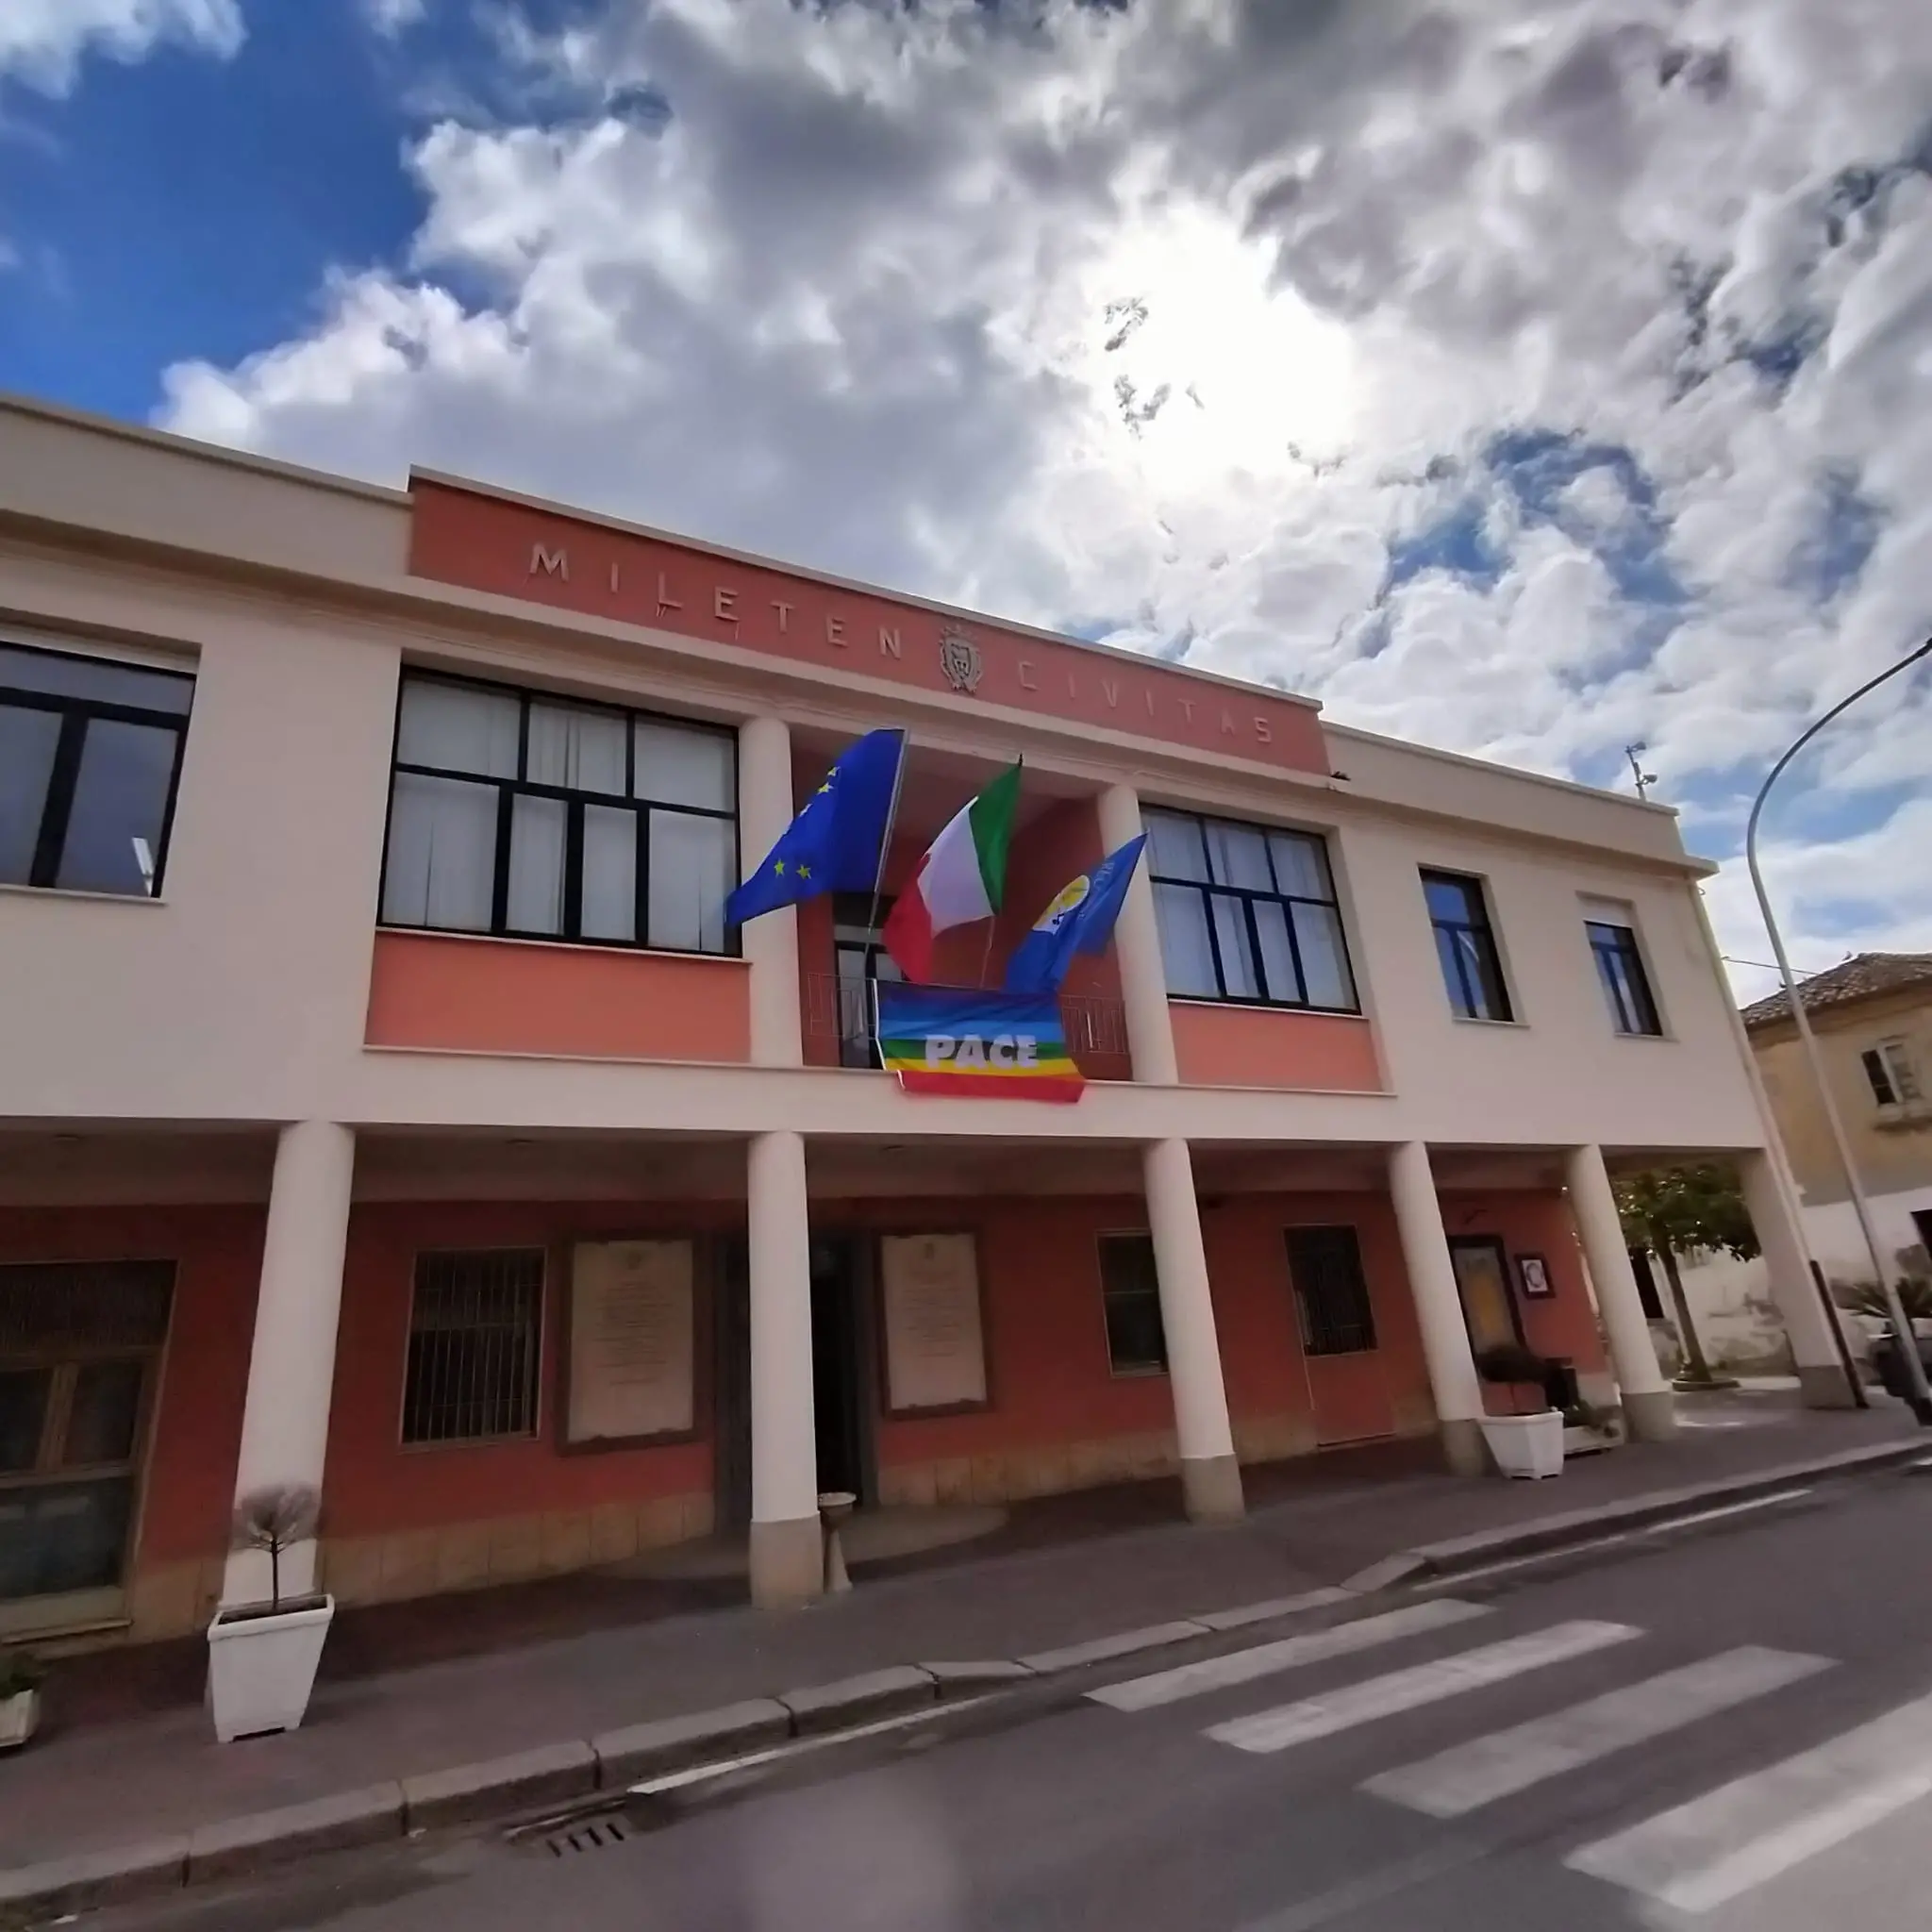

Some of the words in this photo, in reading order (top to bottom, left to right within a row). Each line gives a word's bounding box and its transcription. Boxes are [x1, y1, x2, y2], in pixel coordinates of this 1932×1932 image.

[529, 542, 901, 659] MILETEN
[1018, 661, 1272, 743] CIVITAS
[924, 1033, 1038, 1070] PACE
